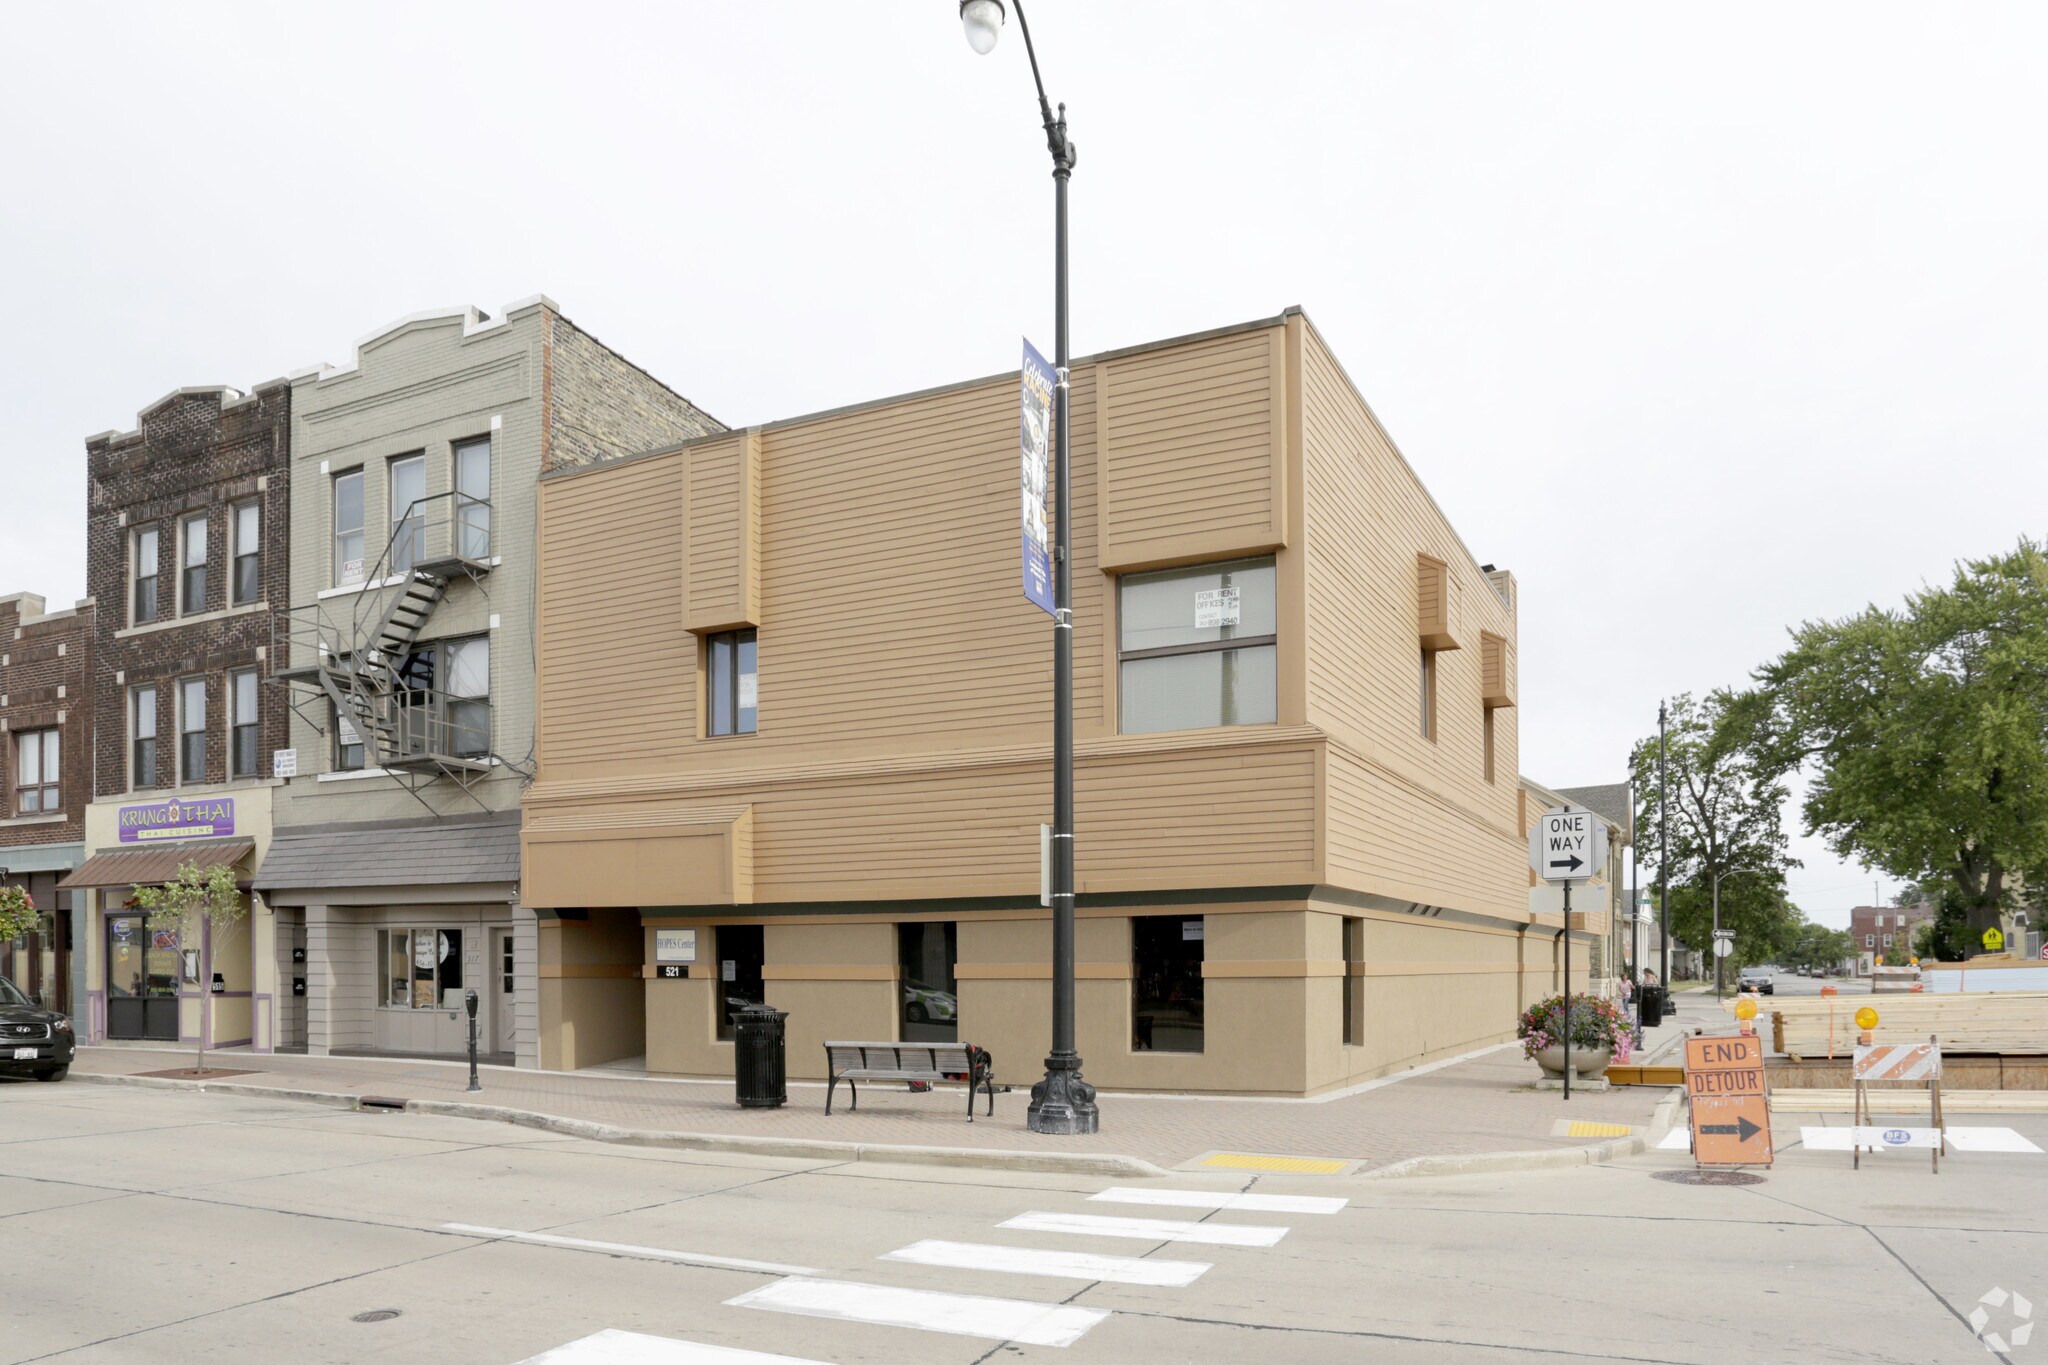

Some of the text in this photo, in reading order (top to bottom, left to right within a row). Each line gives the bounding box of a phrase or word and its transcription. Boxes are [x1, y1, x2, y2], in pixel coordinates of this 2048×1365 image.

[1024, 357, 1053, 396] Celebrate
[1023, 372, 1052, 414] RACINE
[347, 561, 362, 570] FOR
[345, 568, 363, 577] RENT
[1198, 589, 1237, 601] FOR RENT
[1196, 599, 1224, 609] OFFICES
[121, 802, 231, 827] KRUNG THAI
[1550, 817, 1584, 833] ONE
[1550, 835, 1585, 851] WAY
[657, 938, 695, 950] HOPES Center
[665, 966, 679, 977] 521
[213, 982, 224, 991] 515
[1702, 1043, 1747, 1063] END
[1694, 1071, 1758, 1093] DETOUR
[1887, 1131, 1908, 1139] BFS
